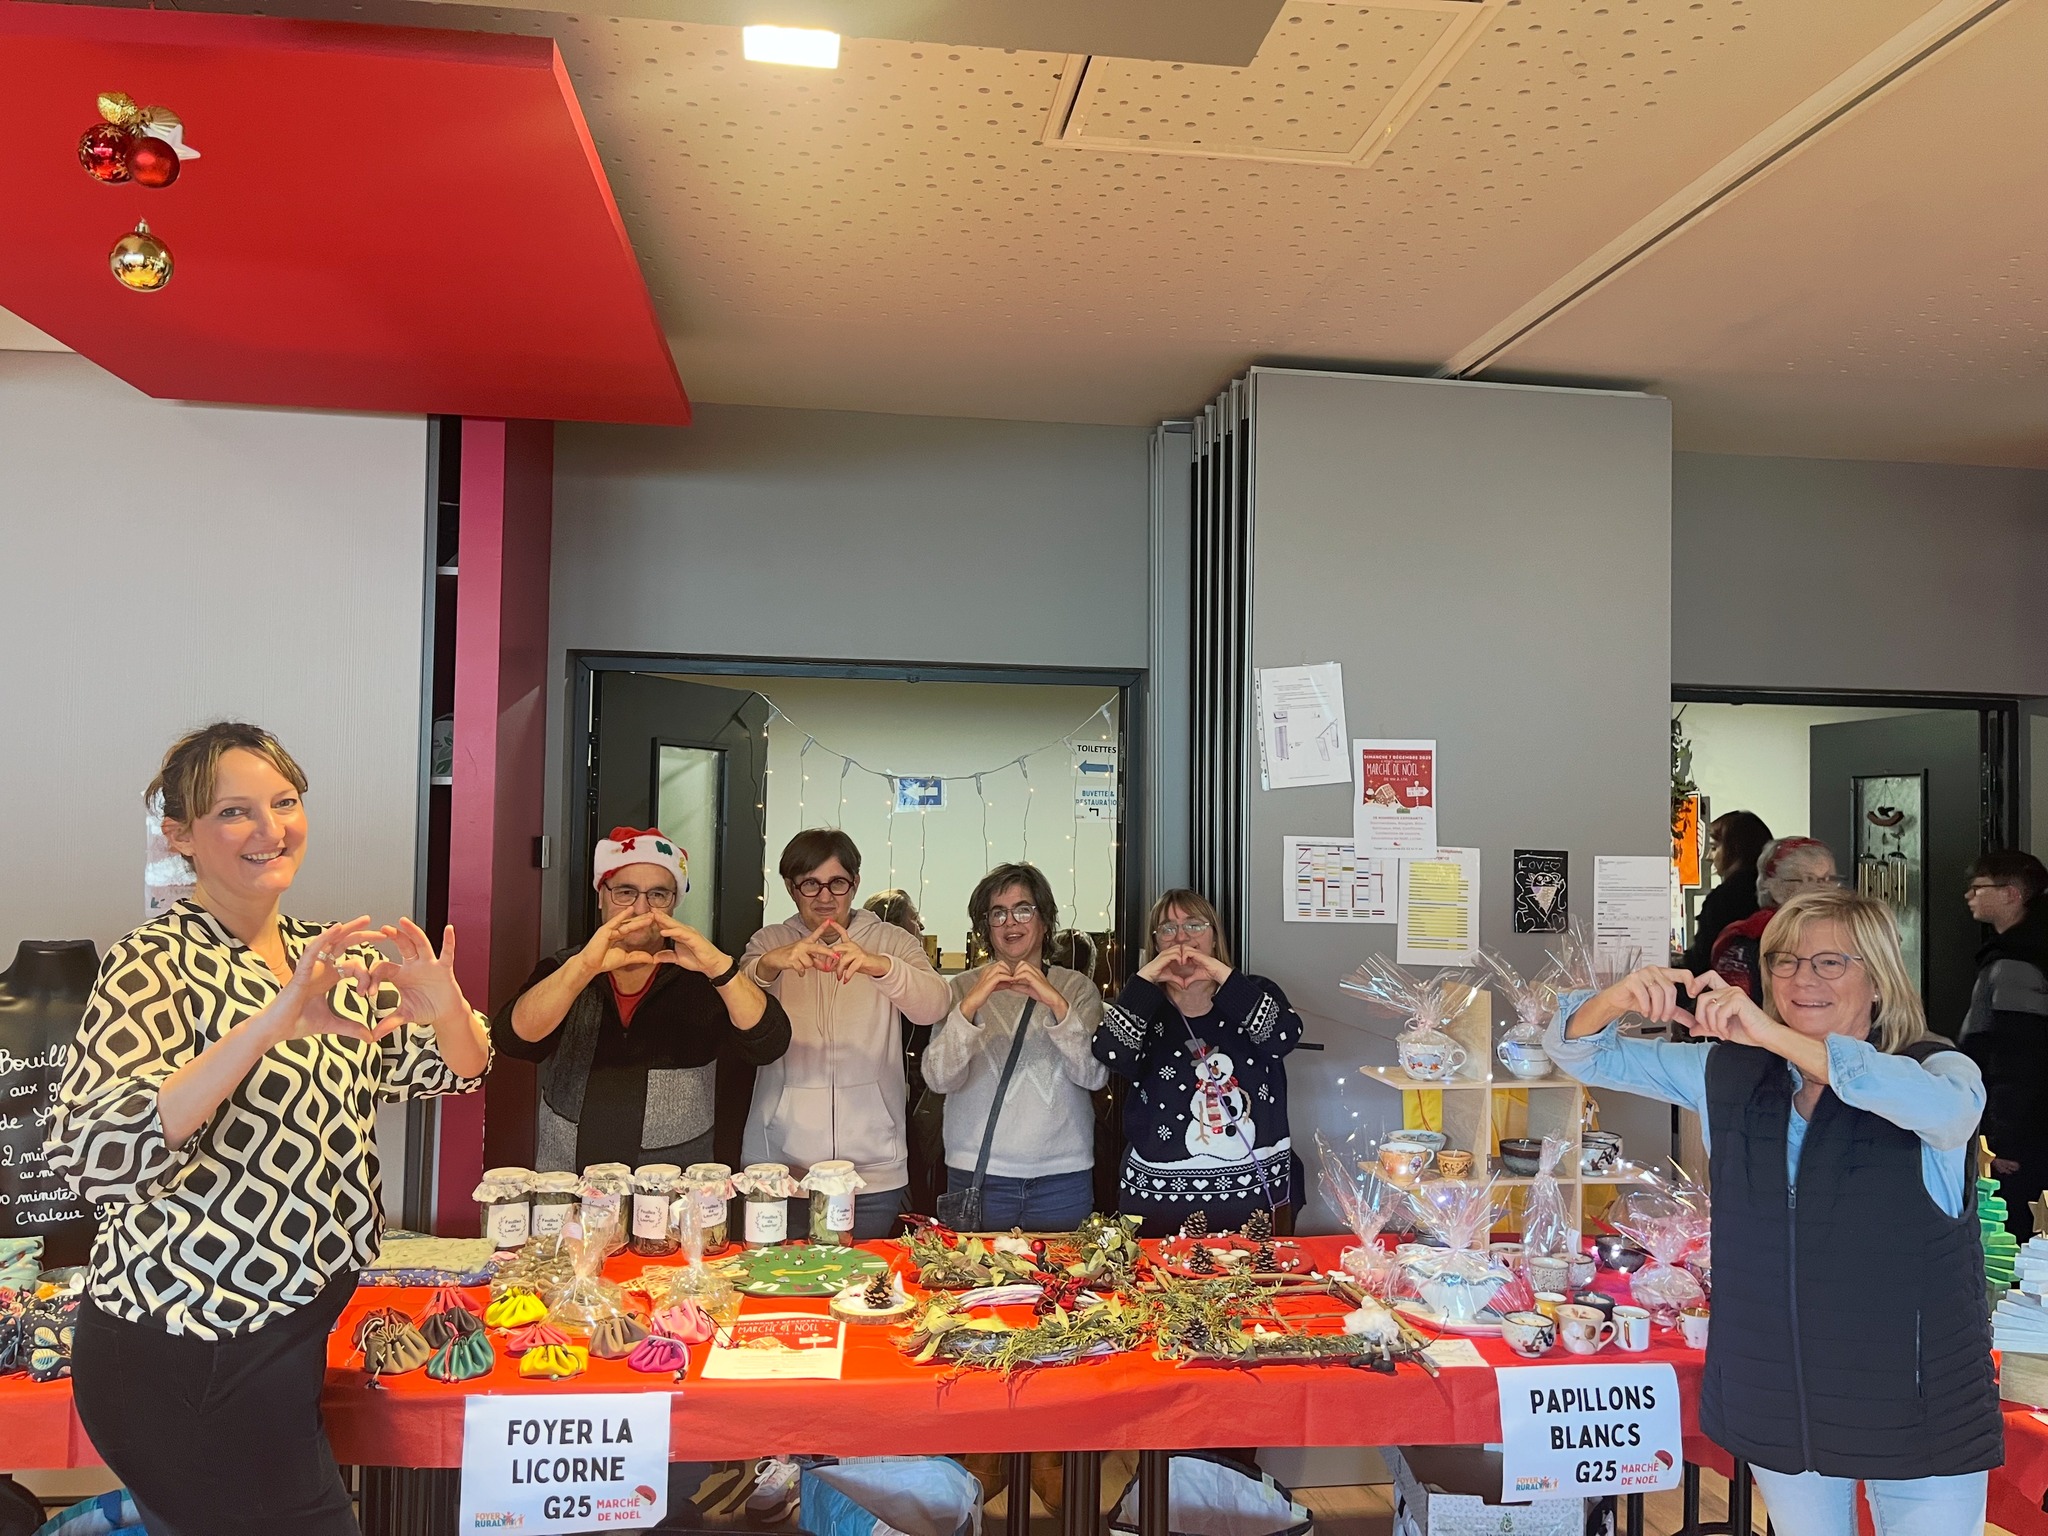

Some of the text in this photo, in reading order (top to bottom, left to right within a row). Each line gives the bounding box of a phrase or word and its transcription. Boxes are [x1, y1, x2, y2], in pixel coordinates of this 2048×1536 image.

[1077, 745, 1116, 753] TOILETTES
[1366, 762, 1390, 776] MARCHÉ
[1393, 763, 1400, 775] DE
[0, 1044, 66, 1076] Bouill
[10, 1082, 62, 1102] aux gr
[0, 1114, 24, 1130] de
[1, 1145, 47, 1166] 2 min
[0, 1187, 77, 1204] 0 minutes
[16, 1208, 84, 1225] Chaleur
[1530, 1386, 1656, 1414] PAPILLONS
[507, 1418, 633, 1445] FOYER LA
[1551, 1423, 1641, 1449] BLANCS
[512, 1456, 625, 1484] LICORNE
[1576, 1460, 1617, 1483] G25
[1621, 1460, 1659, 1473] MARCHÉ
[1621, 1477, 1633, 1485] DE
[544, 1495, 591, 1519] G25
[597, 1495, 640, 1509] MARCHÉ
[475, 1512, 500, 1520] FOYER
[475, 1519, 502, 1528] RURAL
[598, 1512, 611, 1521] DE
